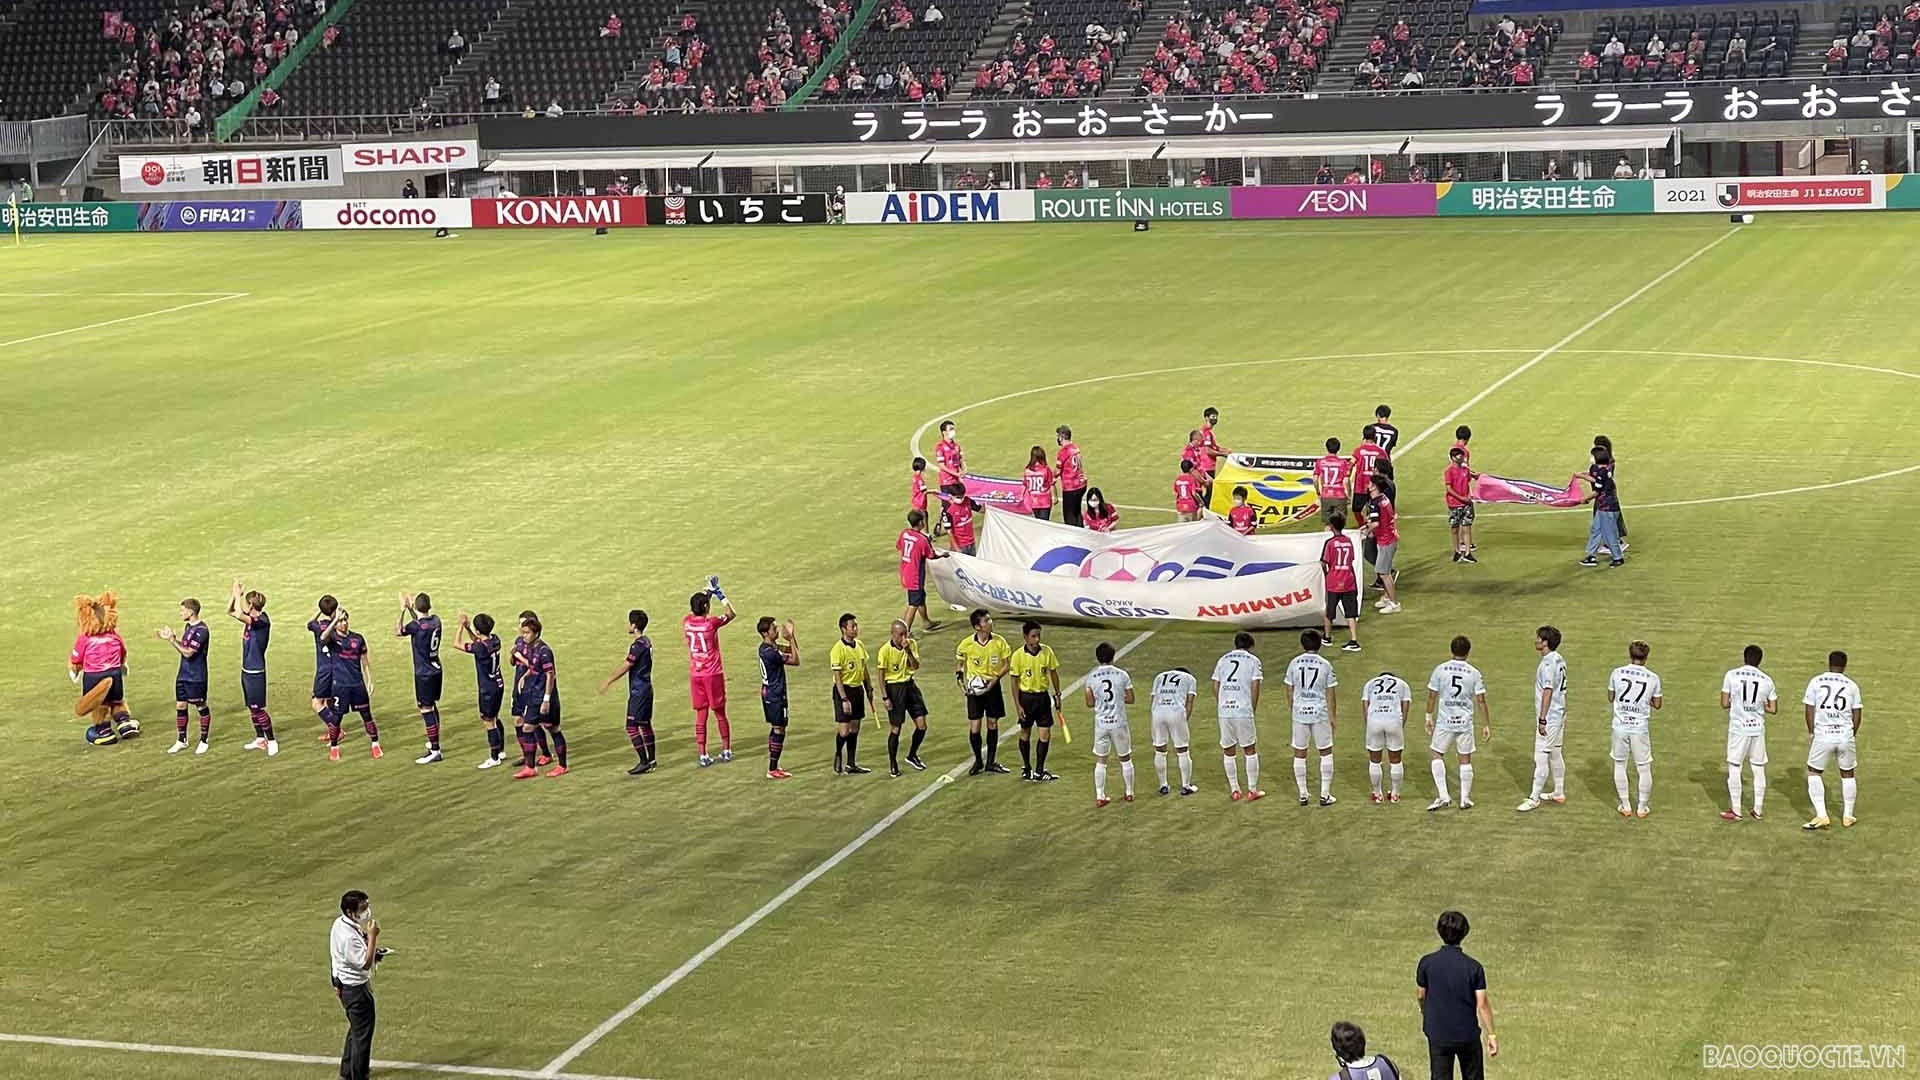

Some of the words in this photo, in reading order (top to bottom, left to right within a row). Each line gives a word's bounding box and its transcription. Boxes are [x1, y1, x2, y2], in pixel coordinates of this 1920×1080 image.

[1535, 95, 1565, 125] ラ
[1592, 91, 1694, 124] ラーラ
[853, 112, 878, 140] ラ
[901, 110, 987, 139] ラーラ
[1012, 102, 1273, 138] おーおーさーかー
[354, 145, 466, 166] SHARP
[202, 155, 329, 185] 朝日新聞
[1472, 185, 1617, 210] 明治安田生命
[1667, 190, 1706, 203] 2021
[1818, 187, 1864, 198] LEAGUE
[337, 204, 435, 226] docomo
[496, 199, 620, 225] KONAMI
[699, 196, 805, 223] いちご
[881, 192, 999, 223] AiDEM
[1041, 199, 1111, 218] ROUTE
[1160, 200, 1223, 217] HOTELS
[1323, 467, 1338, 485] 17
[1337, 547, 1349, 567] 17
[687, 632, 707, 652] 21
[1162, 673, 1181, 688] 14
[1226, 660, 1240, 682] 2
[1298, 667, 1319, 689] 17
[1101, 680, 1114, 703] 3
[1374, 678, 1397, 695] 32
[1451, 675, 1463, 698] 5
[1619, 678, 1647, 705] 27
[1740, 680, 1759, 704] 11
[1820, 685, 1846, 711] 26
